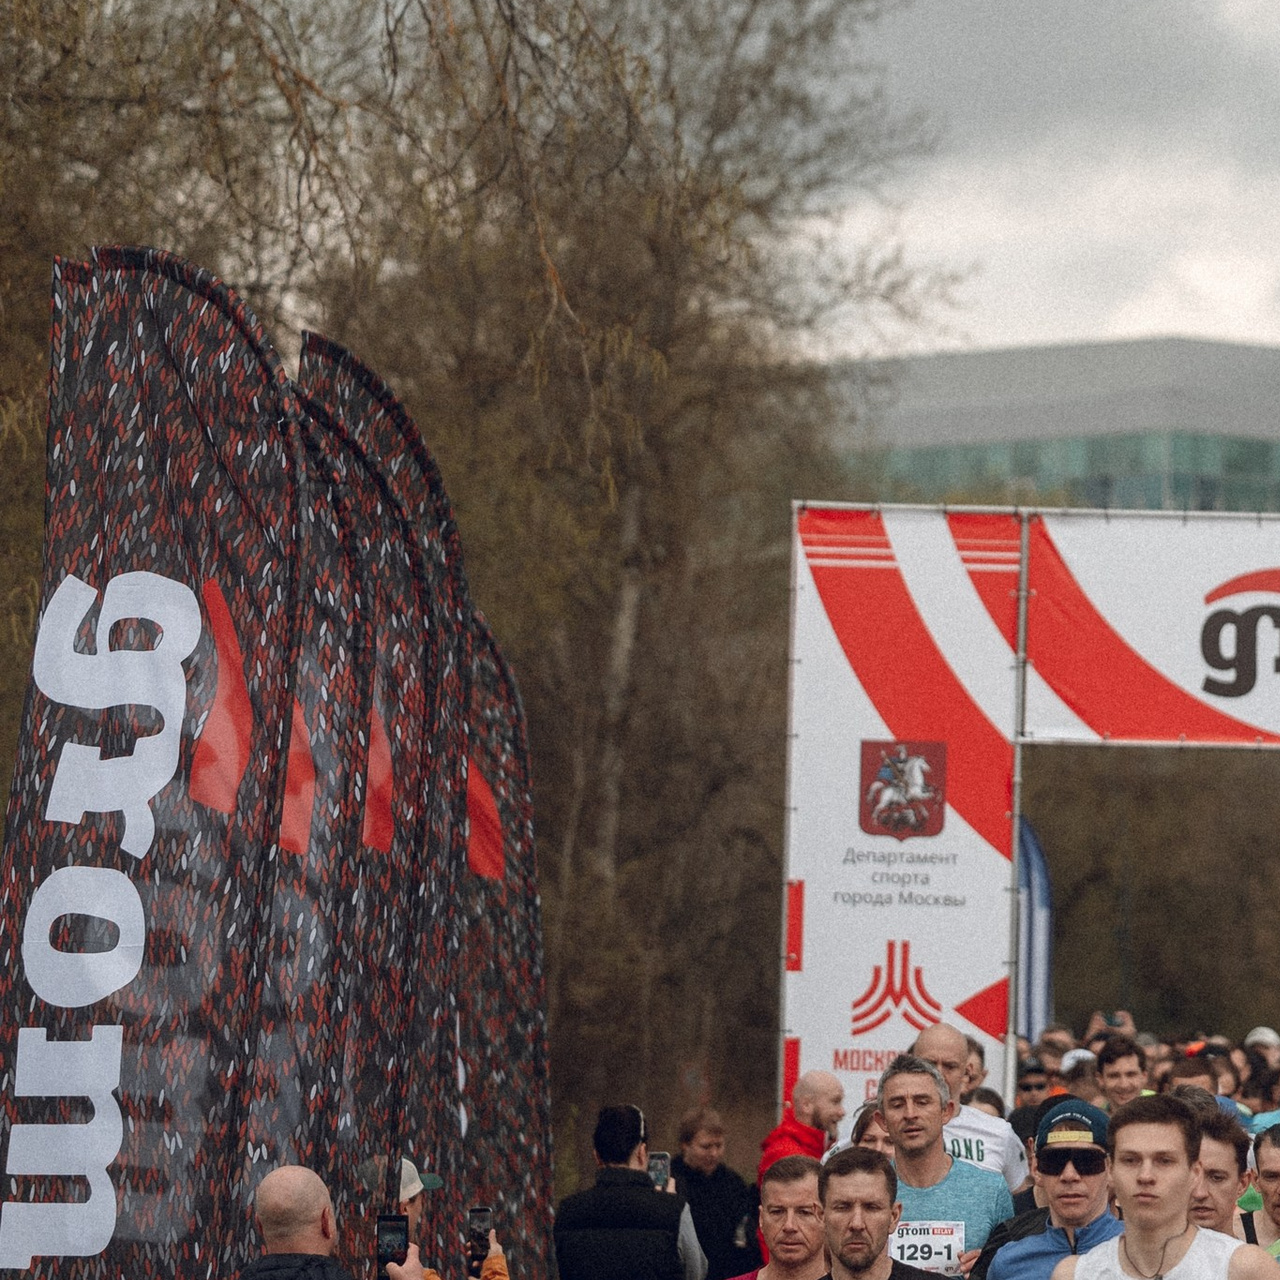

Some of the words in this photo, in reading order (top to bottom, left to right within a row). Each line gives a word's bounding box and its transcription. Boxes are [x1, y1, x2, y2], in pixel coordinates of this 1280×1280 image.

[843, 846, 959, 867] Департамент
[871, 871, 931, 888] спорта
[833, 891, 893, 907] города
[898, 891, 966, 907] Москвы
[0, 571, 202, 1269] grom
[949, 1137, 985, 1163] ONG
[897, 1227, 931, 1239] grom
[896, 1243, 953, 1261] 129-1
